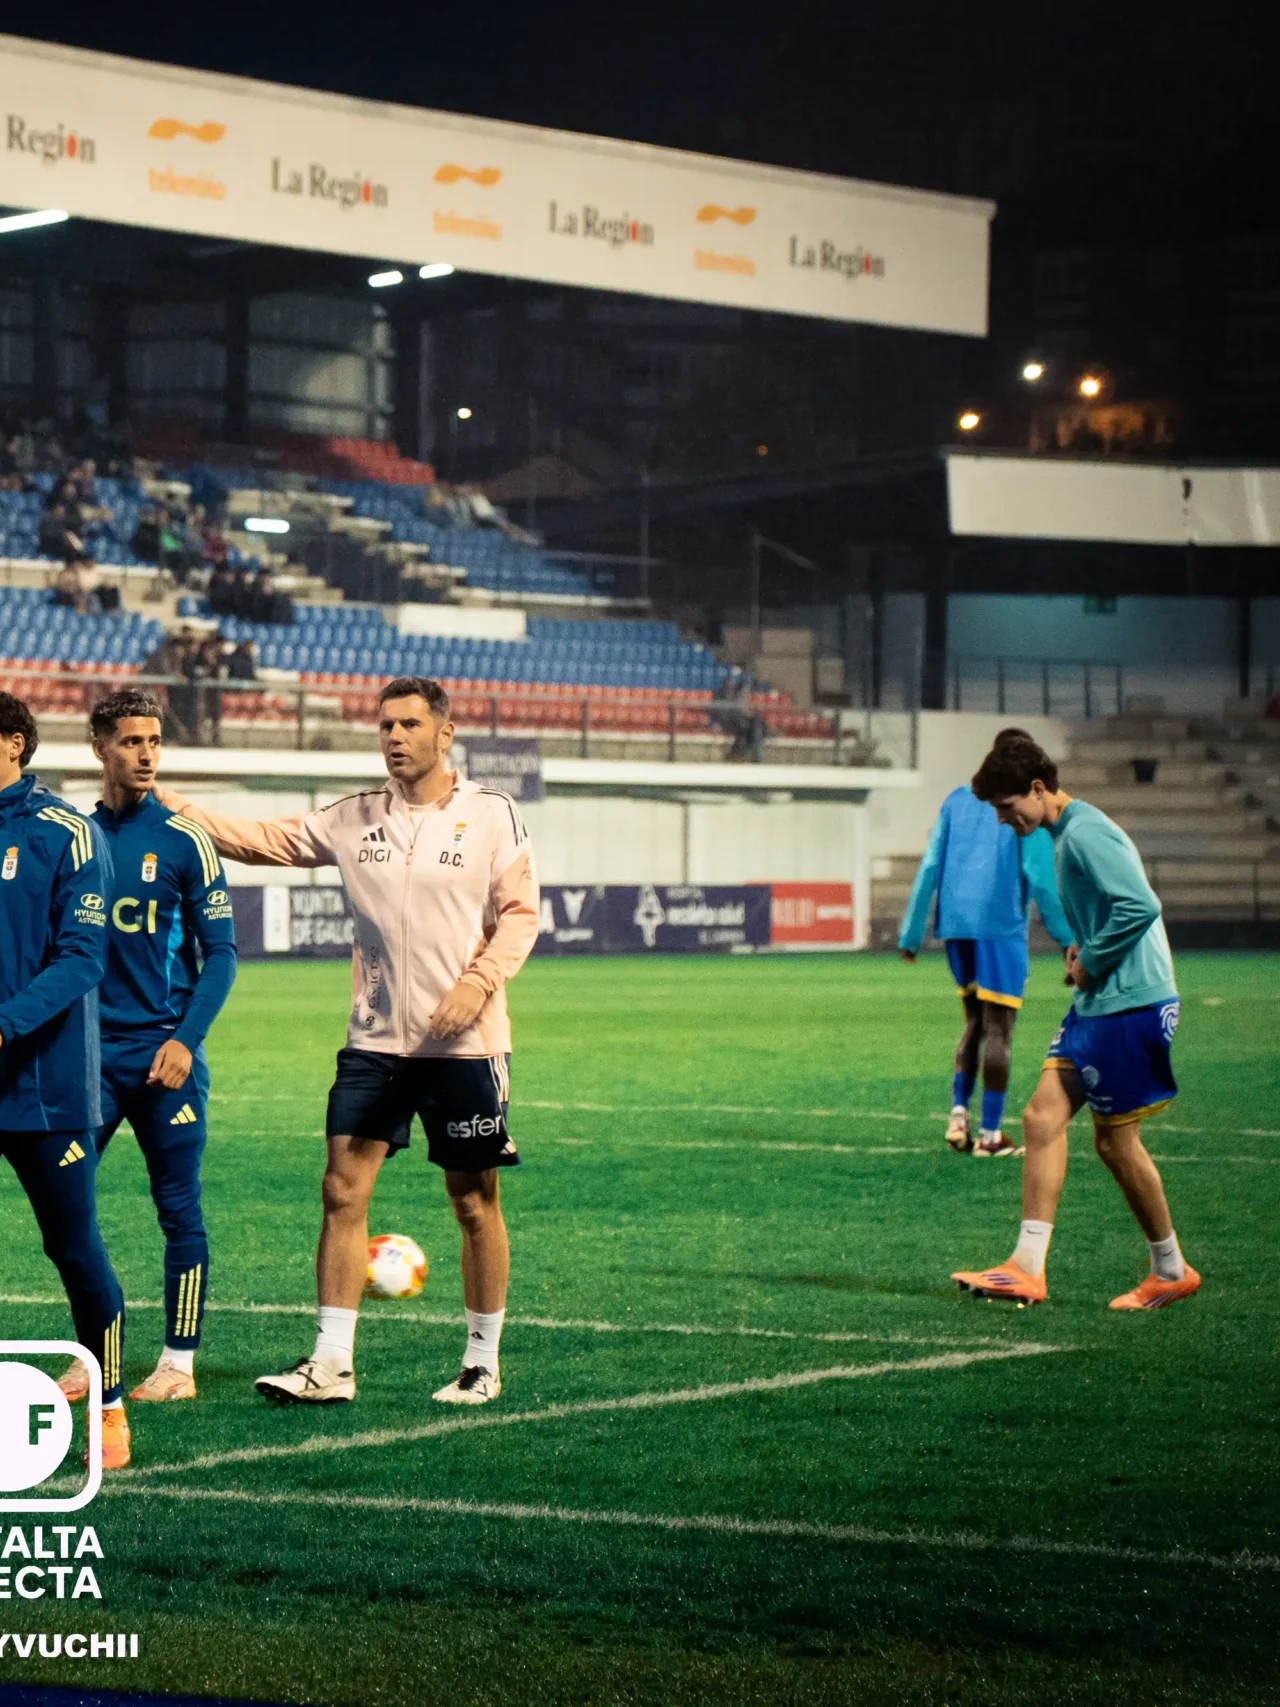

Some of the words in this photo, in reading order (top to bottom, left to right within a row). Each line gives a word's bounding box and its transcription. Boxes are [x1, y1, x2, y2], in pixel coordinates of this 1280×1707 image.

[270, 155, 303, 195] La
[547, 200, 578, 236] La
[788, 235, 817, 268] La
[358, 849, 391, 863] DIGI
[439, 851, 464, 868] D.C.
[447, 1114, 502, 1138] esfer
